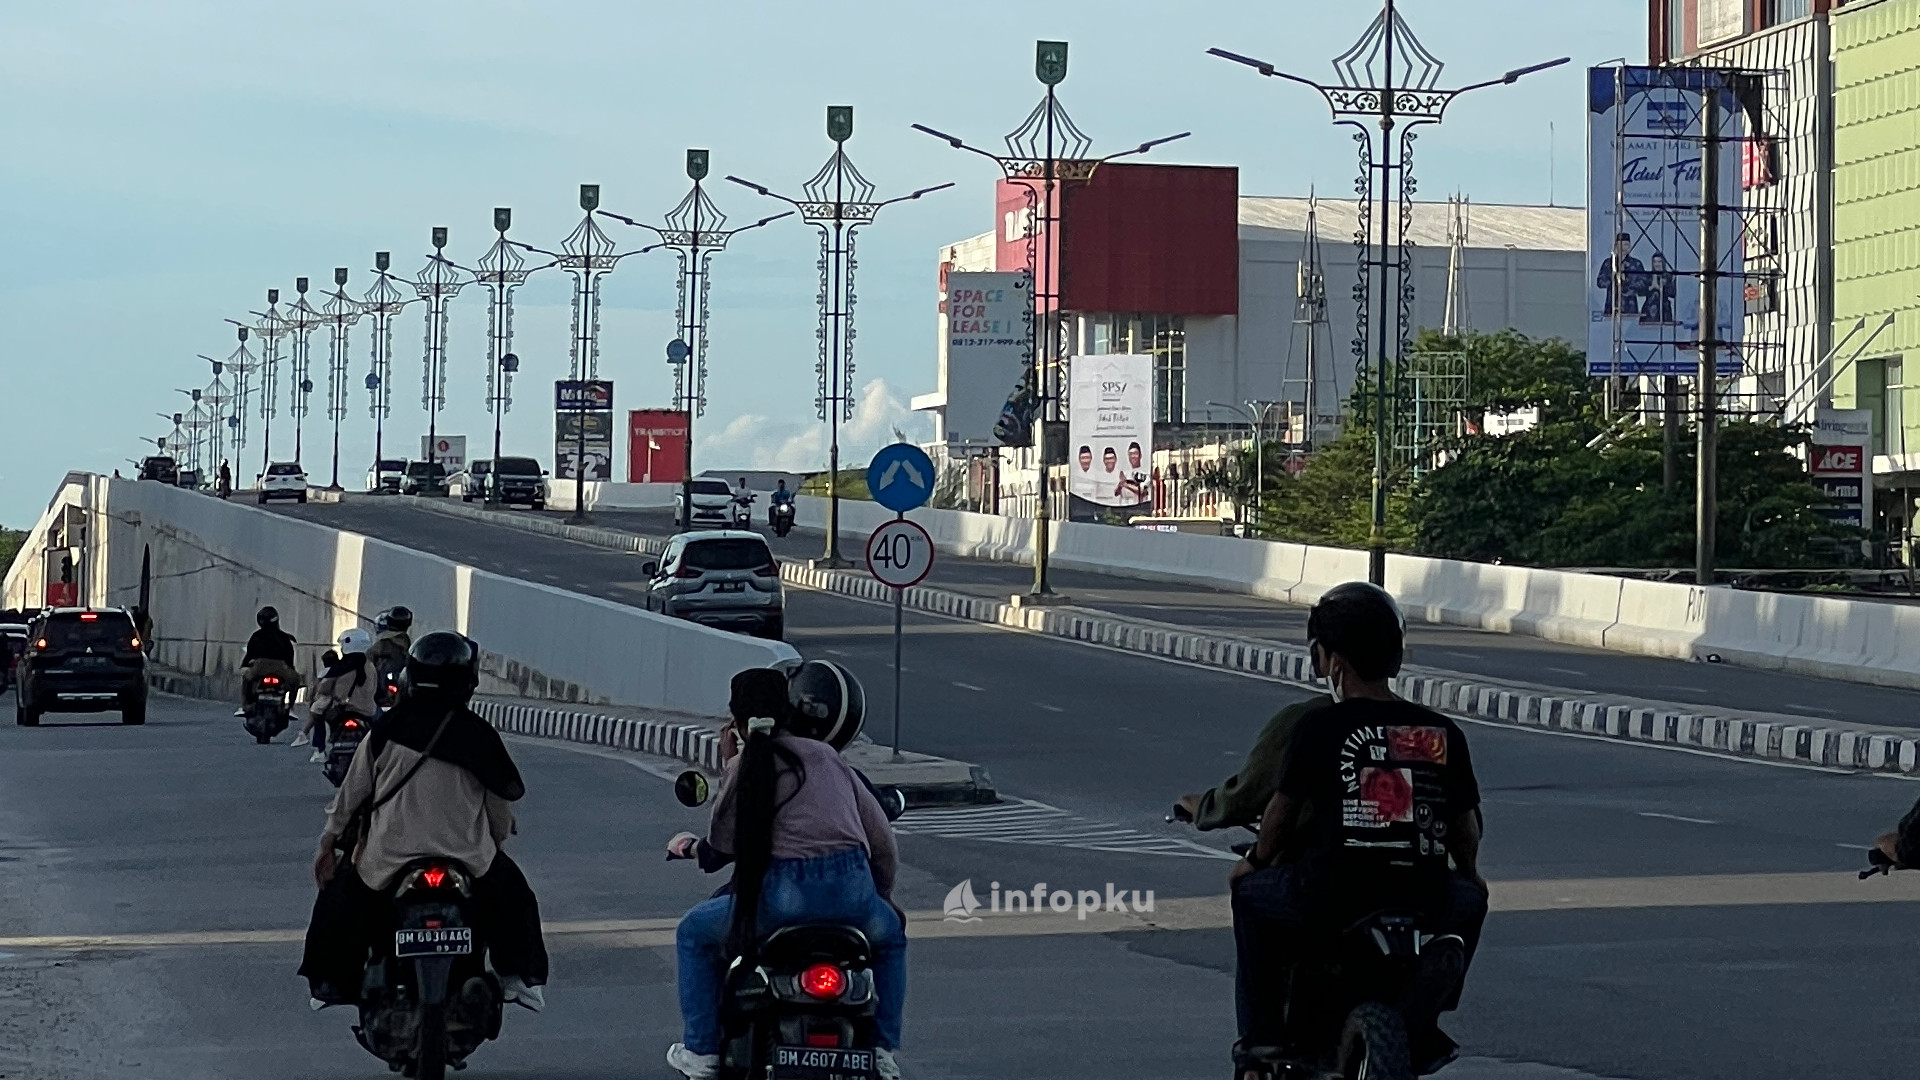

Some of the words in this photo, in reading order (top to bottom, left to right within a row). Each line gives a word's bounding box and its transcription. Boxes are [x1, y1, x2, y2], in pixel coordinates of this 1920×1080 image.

[1622, 157, 1663, 184] Idul
[952, 289, 1004, 303] SPACE
[952, 305, 986, 318] FOR
[952, 320, 1001, 333] LEASE
[1818, 449, 1858, 469] ACE
[873, 534, 911, 569] 40
[399, 932, 413, 944] BM
[780, 1050, 798, 1066] BM
[801, 1052, 838, 1068] 4607
[843, 1054, 869, 1070] ABE
